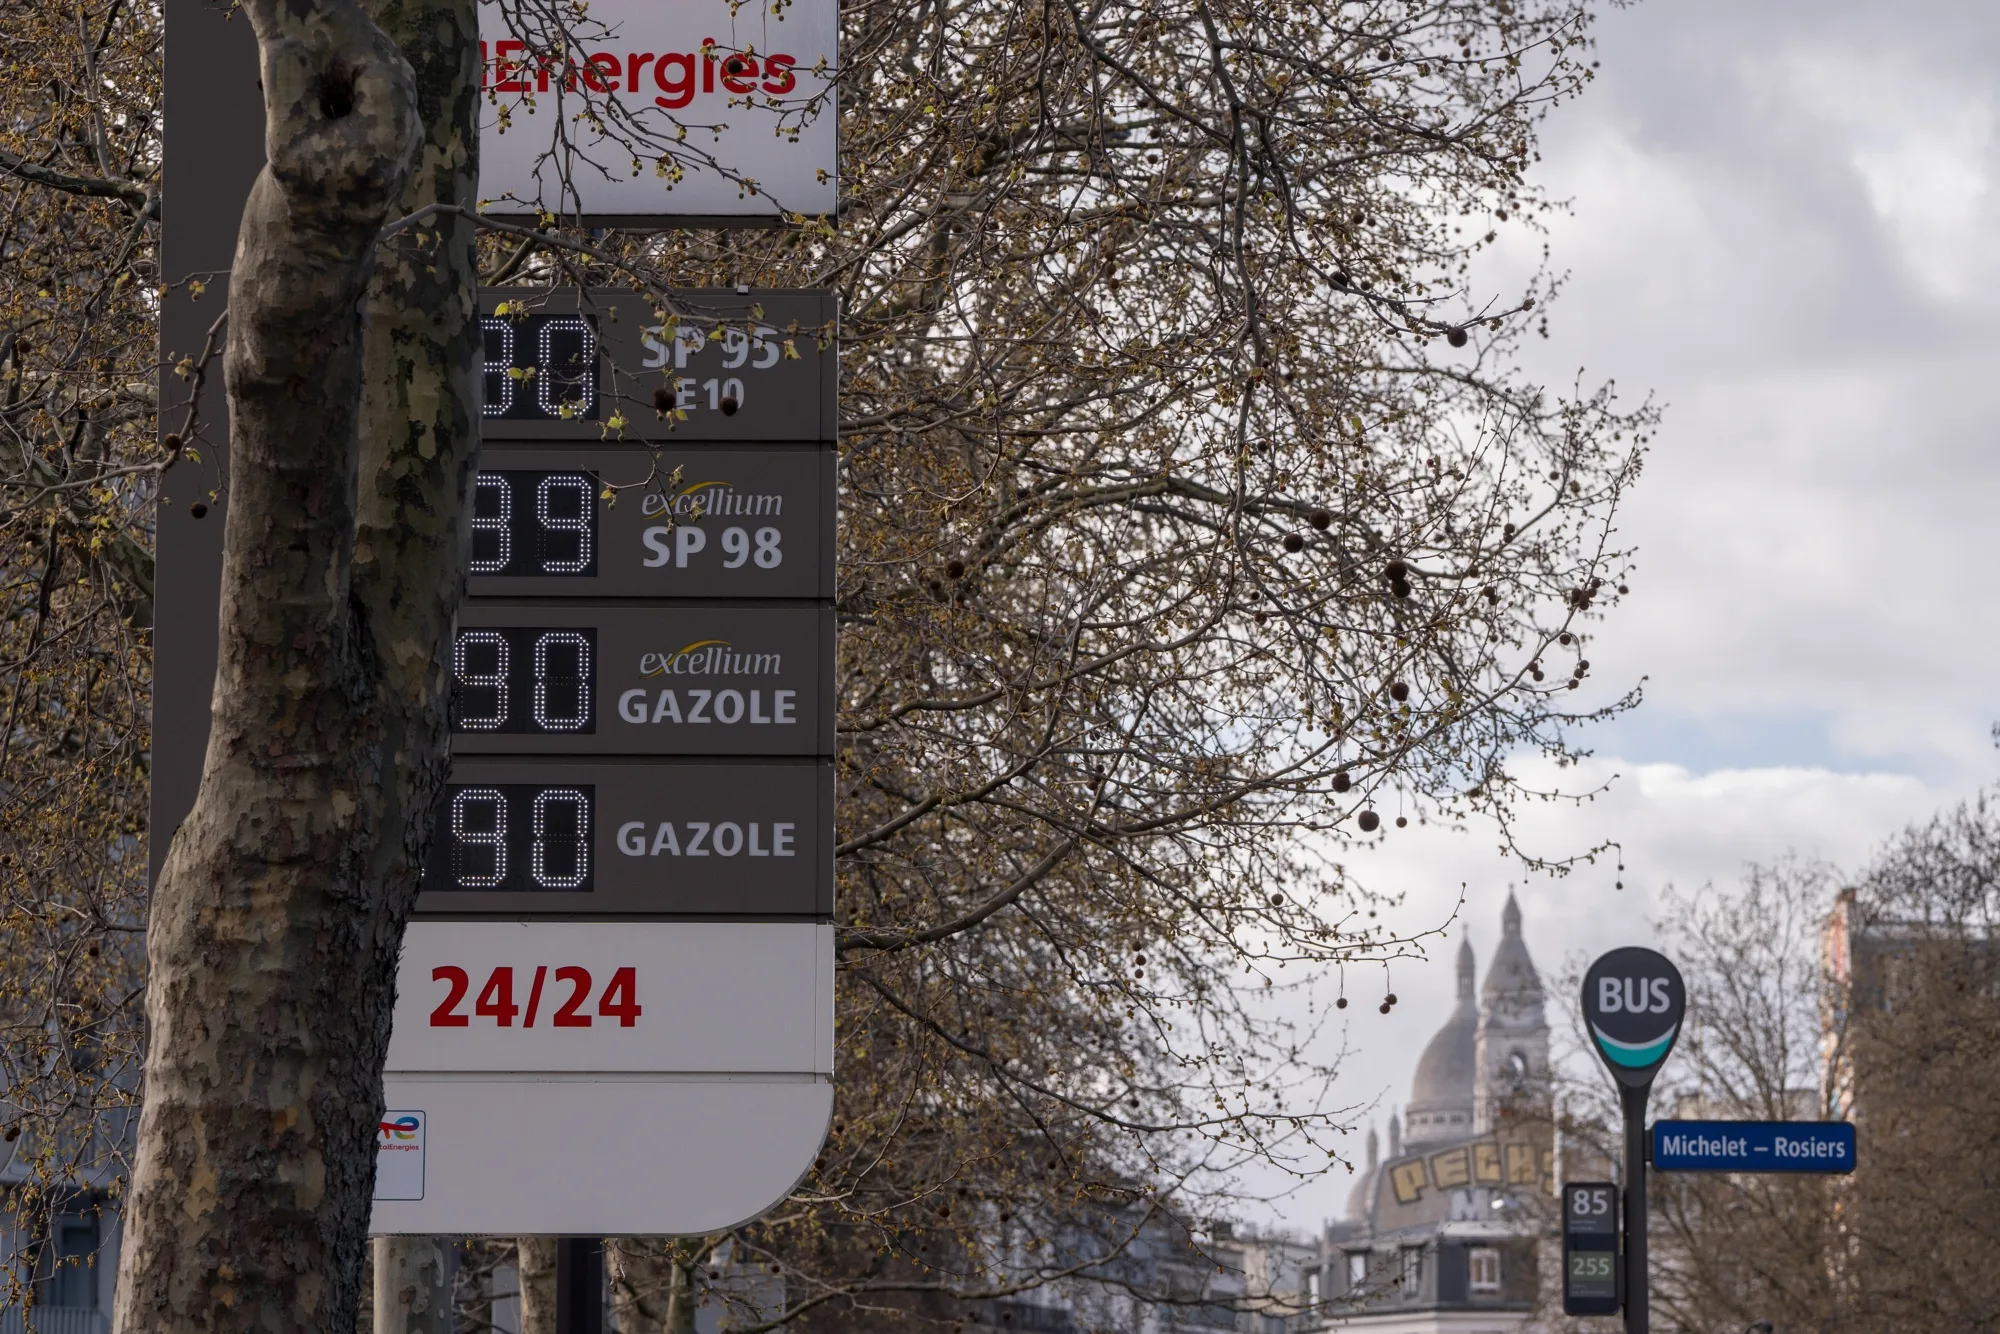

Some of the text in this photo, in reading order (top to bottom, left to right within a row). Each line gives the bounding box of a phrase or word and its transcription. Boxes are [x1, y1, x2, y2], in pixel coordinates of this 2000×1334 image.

[641, 325, 781, 369] SP 95
[641, 487, 783, 517] excellium
[641, 526, 783, 570] SP 98
[639, 647, 781, 676] excellium
[617, 688, 797, 725] GAZOLE
[616, 820, 796, 857] GAZOLE
[429, 965, 642, 1029] 24/24
[1599, 976, 1671, 1014] BUS
[1662, 1135, 1748, 1157] Michelet
[1774, 1136, 1846, 1158] Rosiers
[1572, 1189, 1609, 1216] 85
[1572, 1257, 1611, 1276] 255
